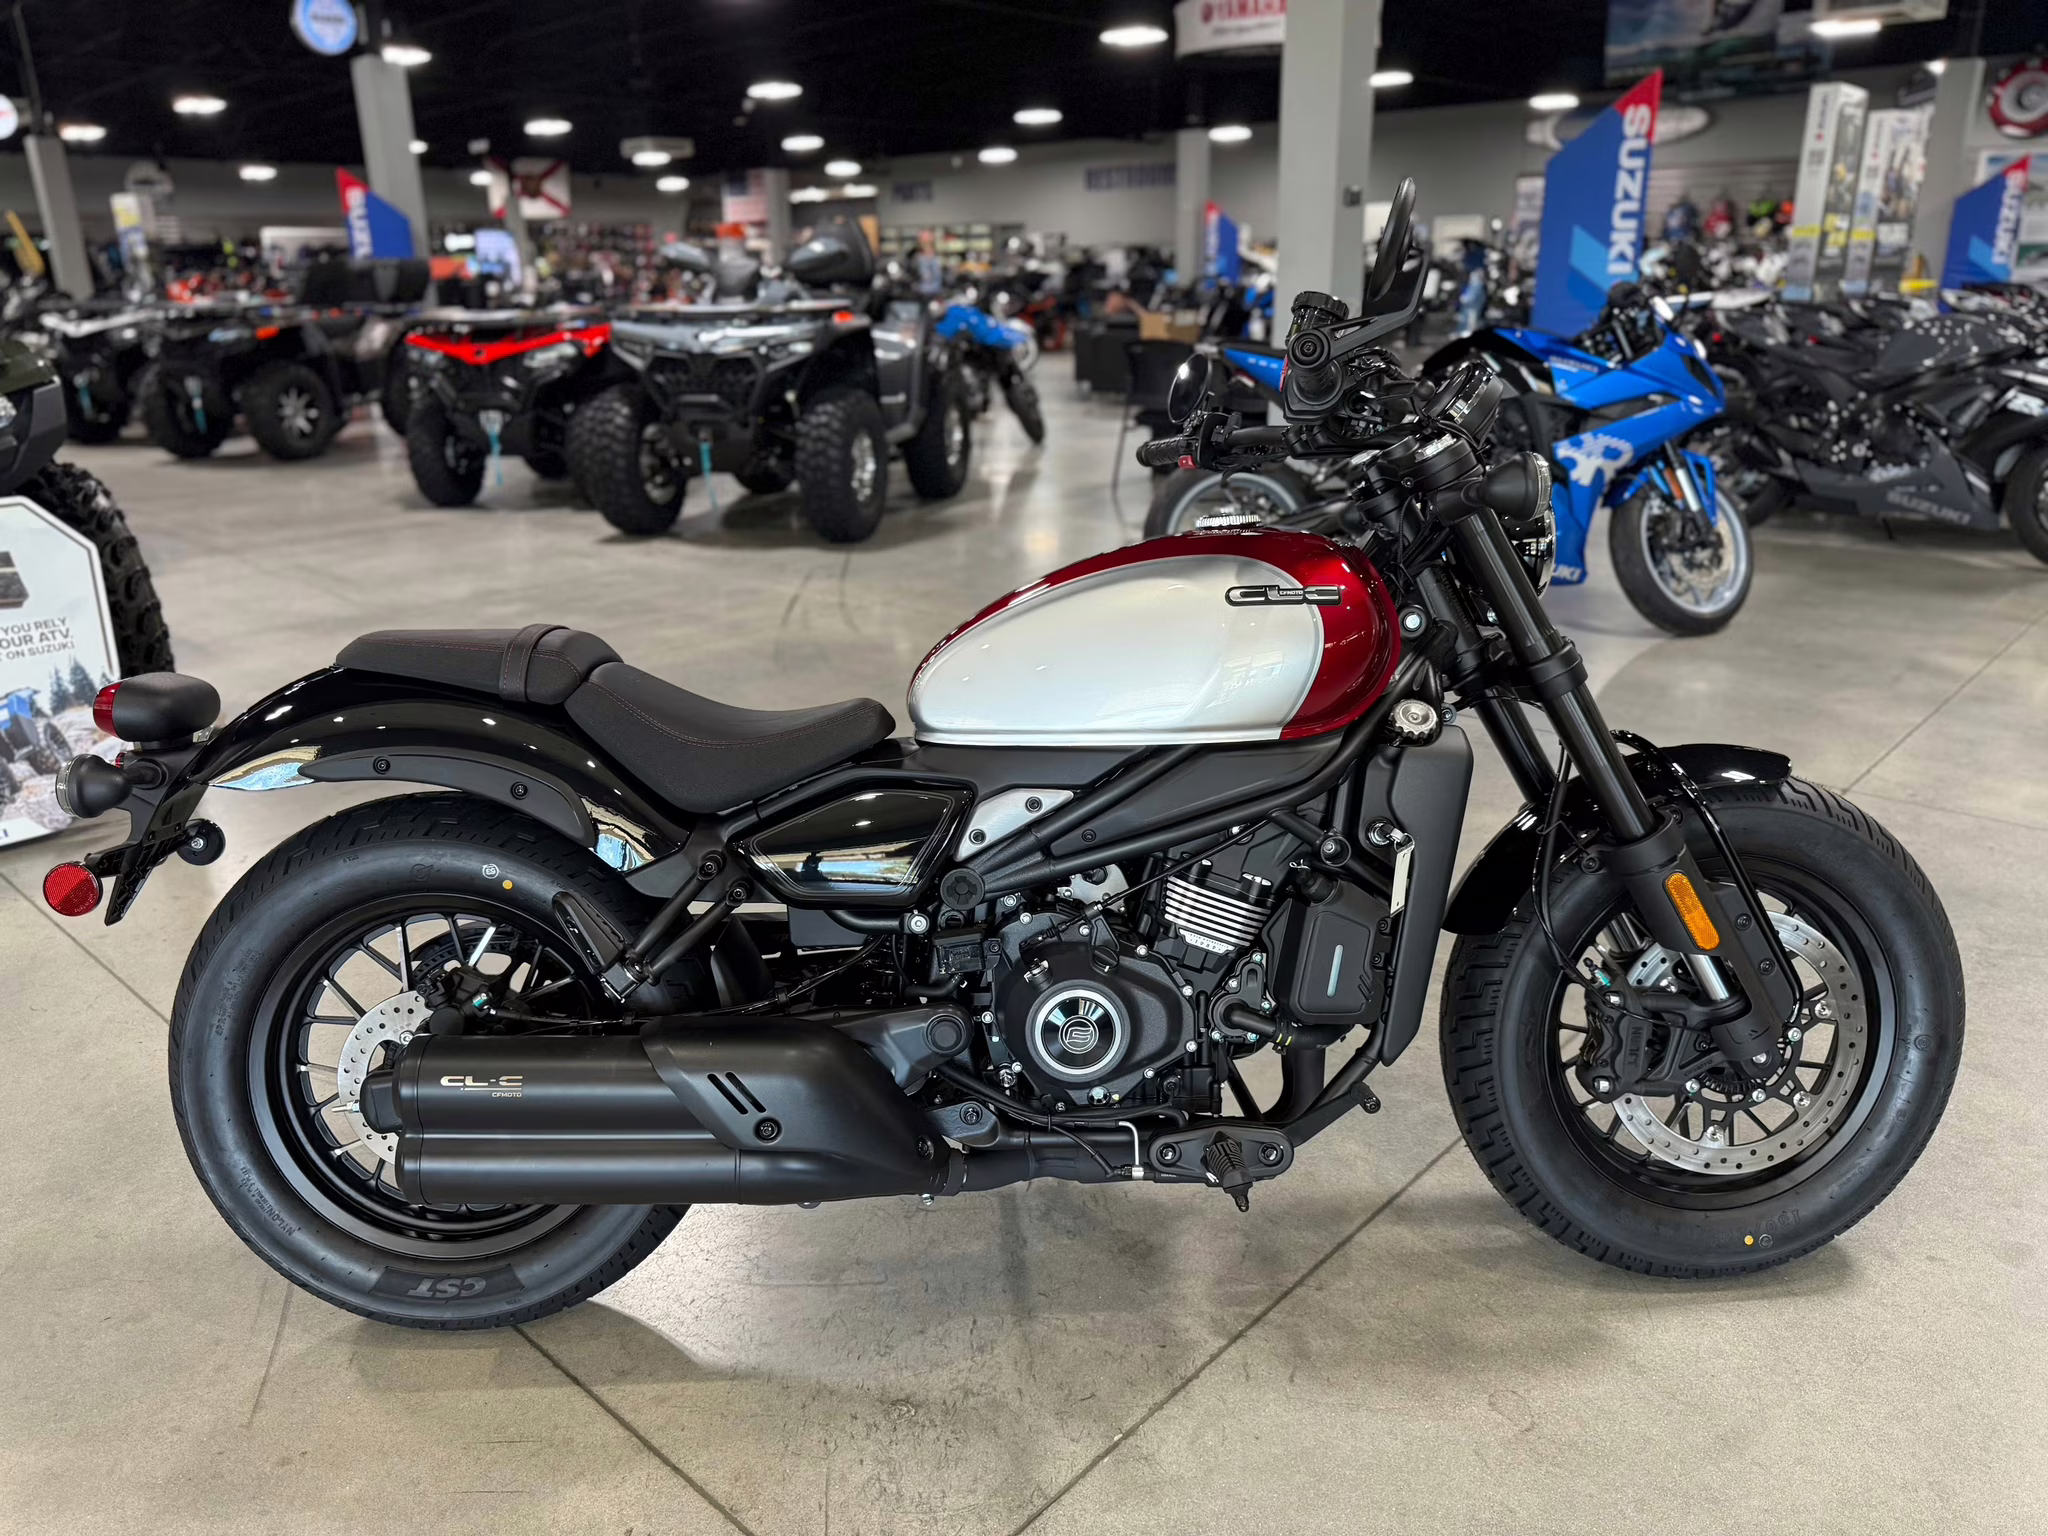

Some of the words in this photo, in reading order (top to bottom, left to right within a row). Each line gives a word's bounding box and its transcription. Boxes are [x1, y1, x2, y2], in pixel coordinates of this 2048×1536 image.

[1607, 103, 1652, 275] SUZUKI
[1887, 489, 1971, 526] SUZUKI
[1, 622, 31, 636] YOU
[34, 616, 67, 631] RELY
[6, 648, 26, 660] ON
[28, 640, 76, 657] SUZUKI
[265, 1208, 296, 1237] NYLON
[407, 1276, 487, 1299] CST
